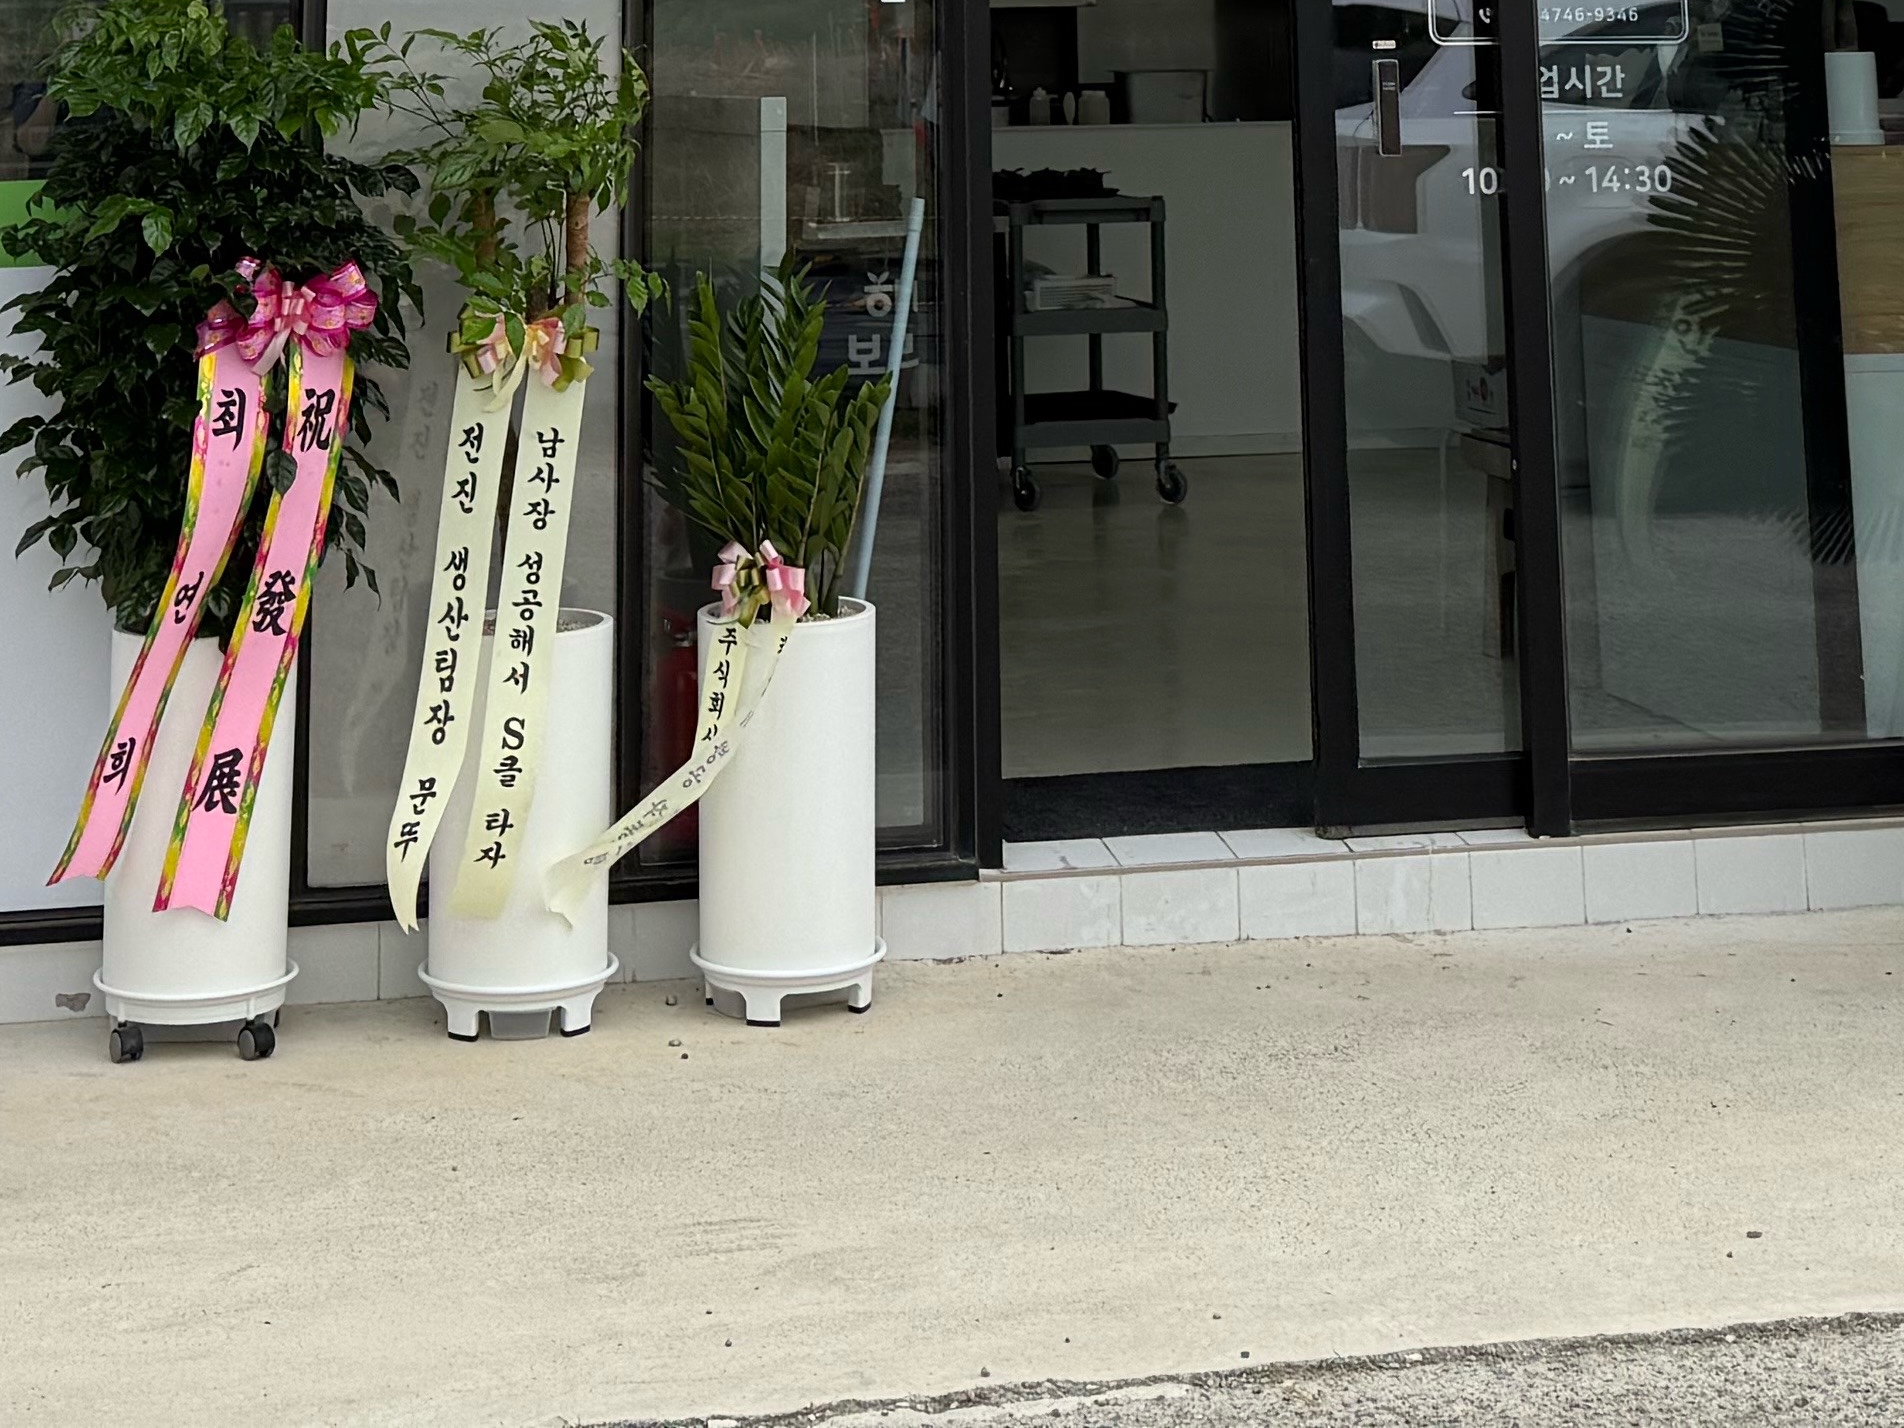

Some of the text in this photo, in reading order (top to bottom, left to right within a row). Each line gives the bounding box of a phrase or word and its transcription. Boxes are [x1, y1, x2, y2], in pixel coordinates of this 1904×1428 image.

[1539, 64, 1626, 99] 업시간
[1541, 6, 1639, 23] 4746-9346
[1583, 122, 1613, 149] 토
[1584, 164, 1672, 193] 14:30
[101, 387, 248, 796] 최연희
[192, 385, 336, 817] 祝發展
[393, 421, 485, 863] 전진 생산팀장 문뚜
[472, 427, 566, 871] 남사장 성공해서 S클 타자
